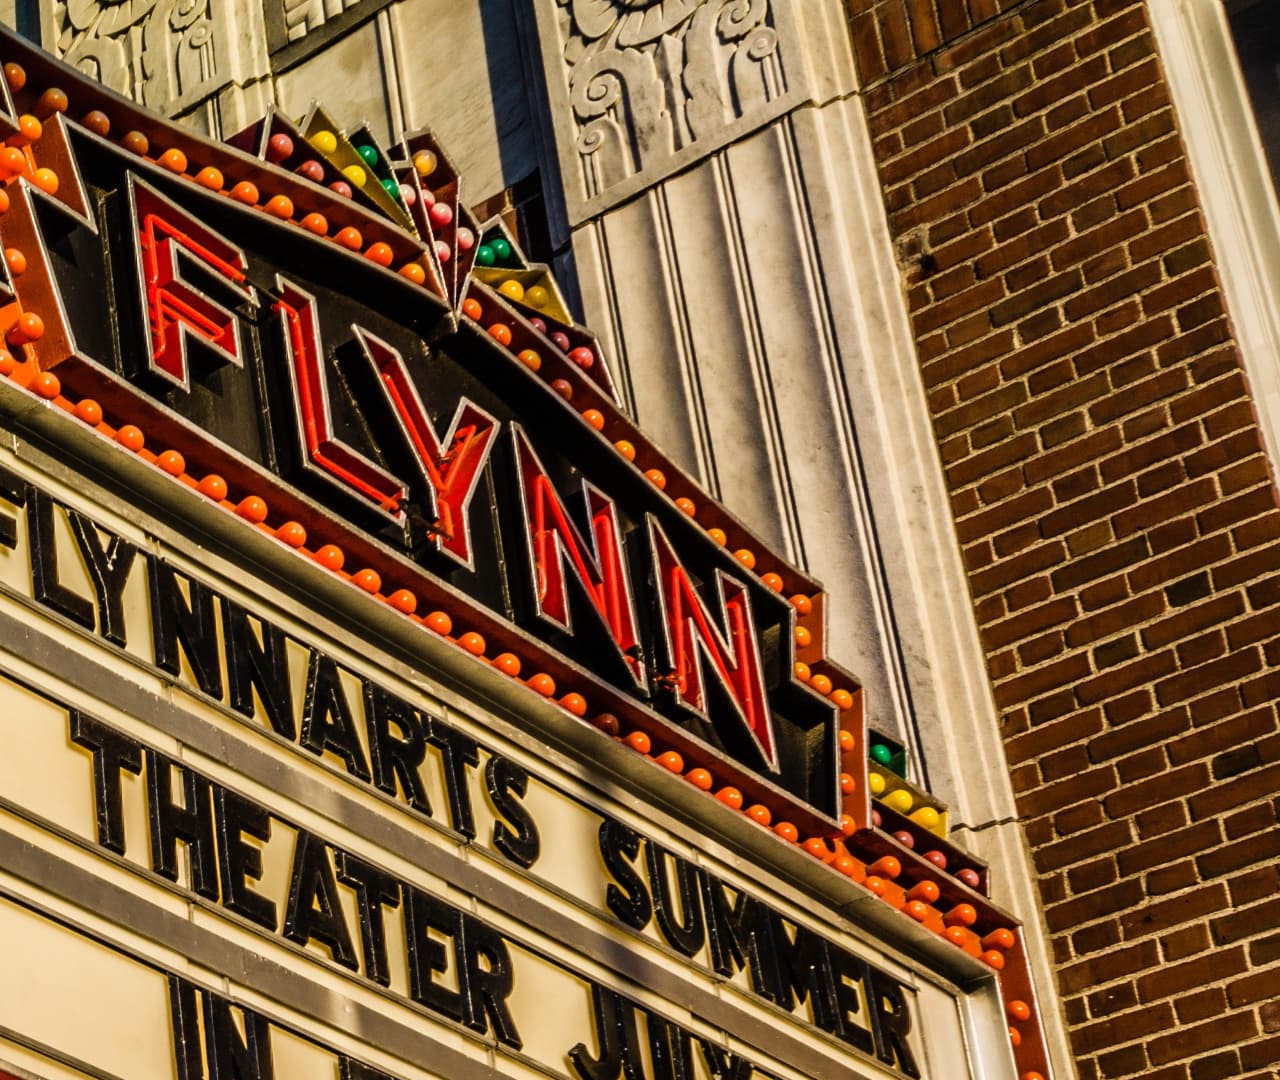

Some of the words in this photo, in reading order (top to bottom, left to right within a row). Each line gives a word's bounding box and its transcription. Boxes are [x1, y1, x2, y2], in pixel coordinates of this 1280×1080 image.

[128, 170, 780, 773] FLYNN
[68, 711, 523, 1051] THEATER
[598, 818, 920, 1080] SUMMER
